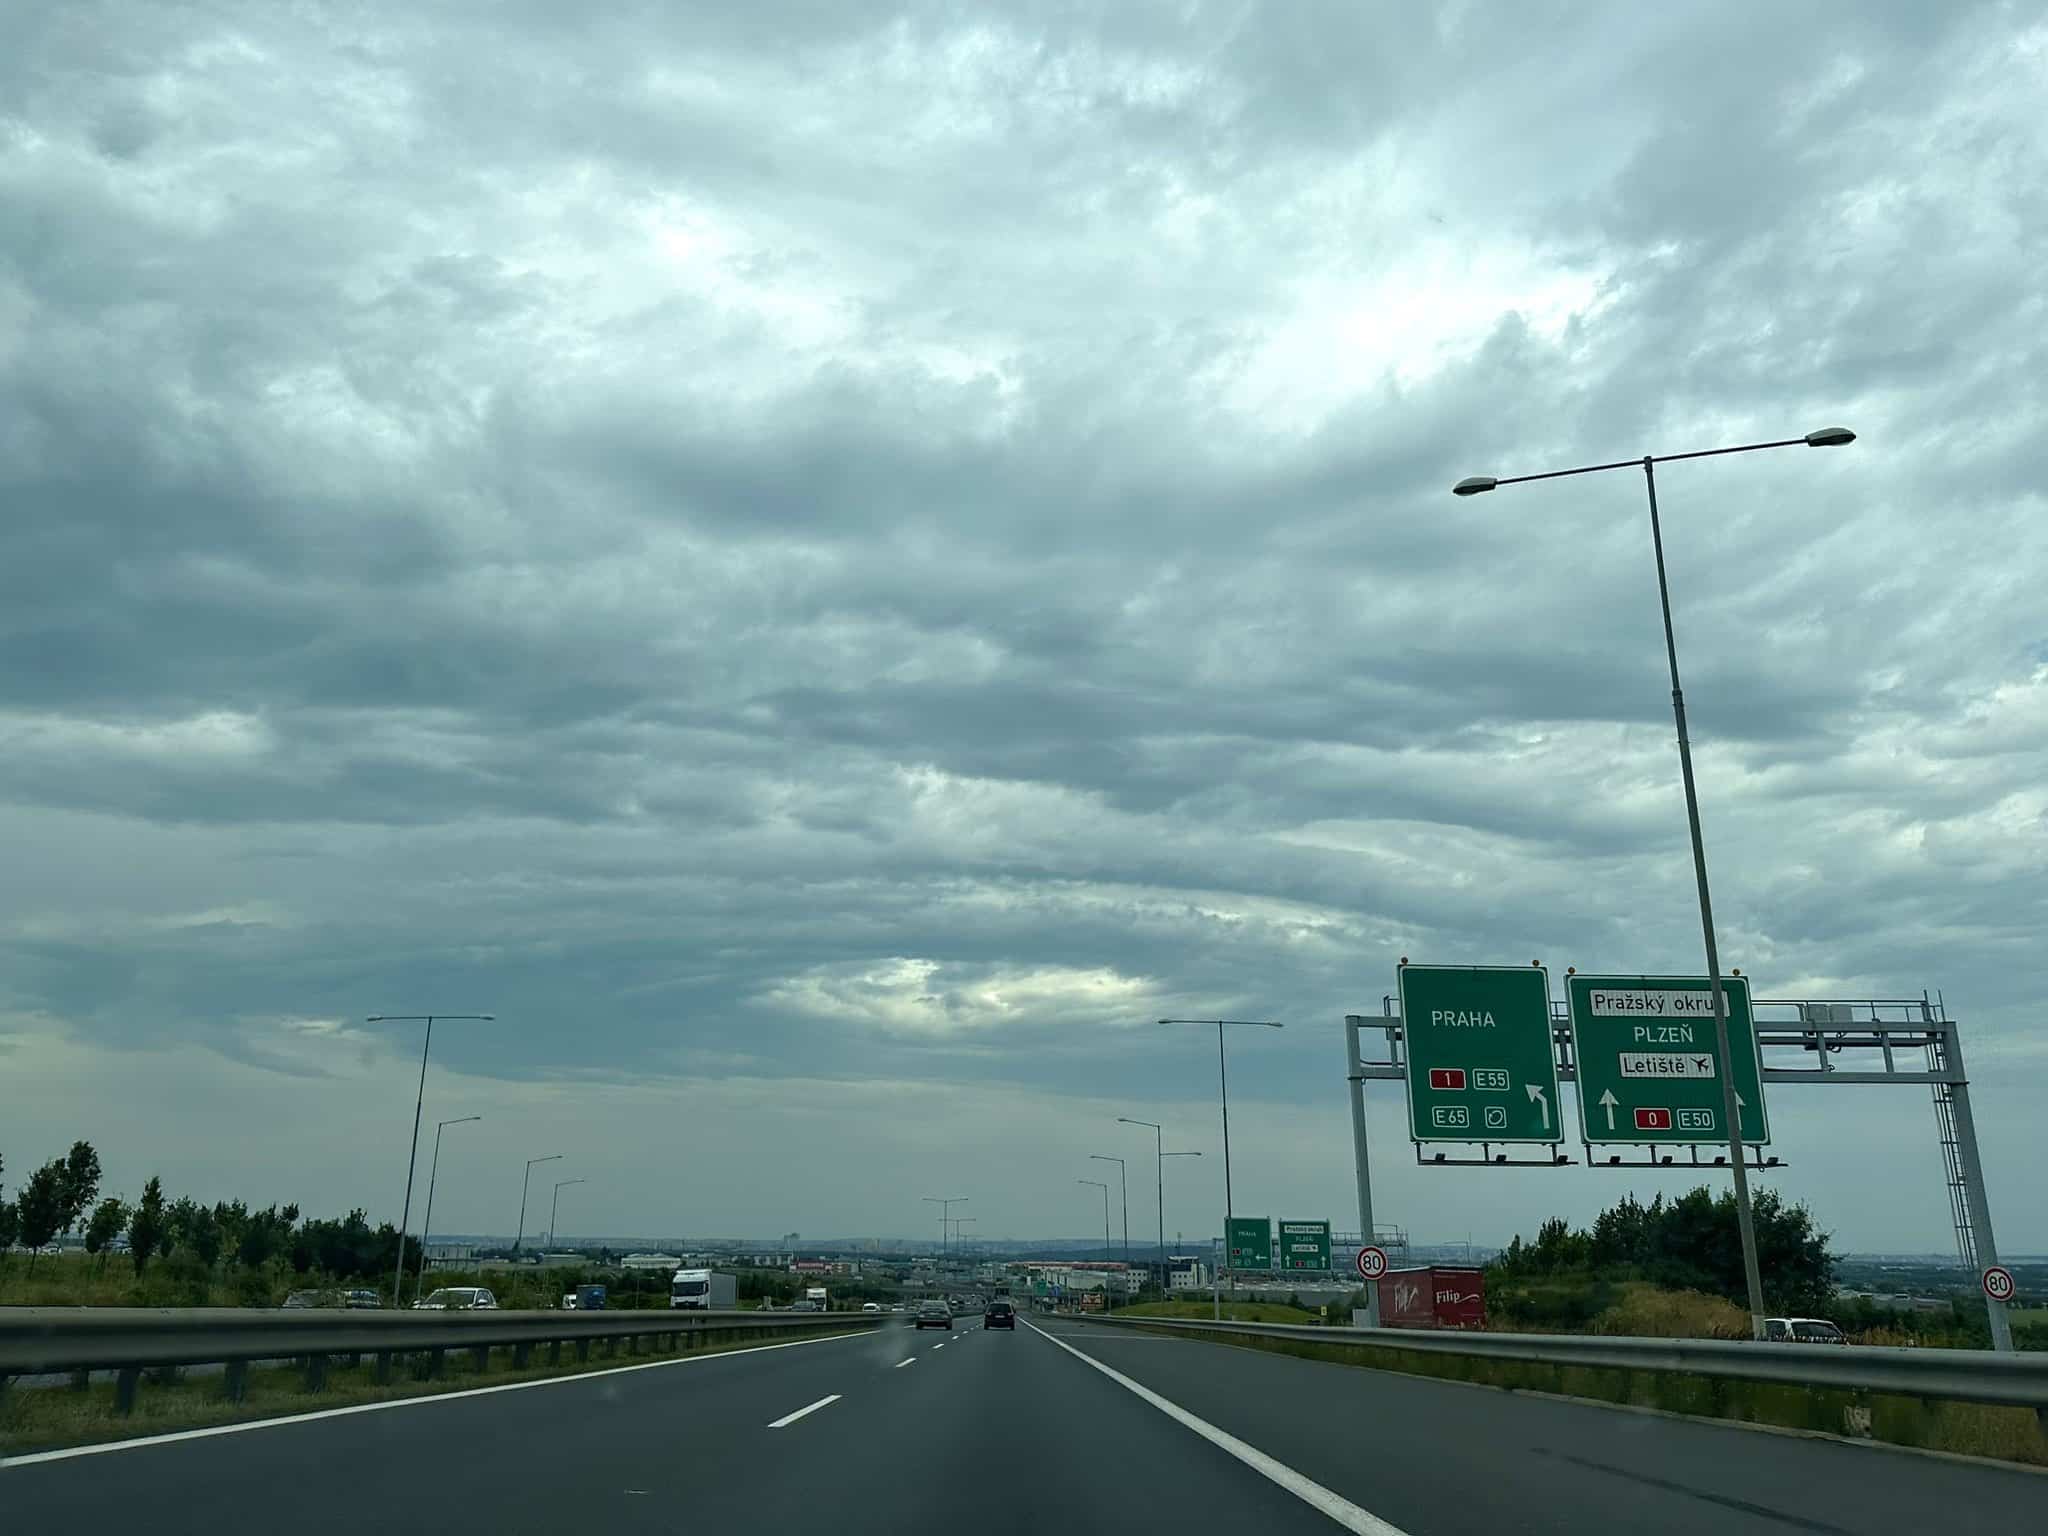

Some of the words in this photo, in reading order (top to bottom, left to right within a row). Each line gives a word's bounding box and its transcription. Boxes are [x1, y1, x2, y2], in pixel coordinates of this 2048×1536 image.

[1594, 993, 1665, 1014] Pražský
[1674, 995, 1714, 1011] okru
[1431, 1010, 1496, 1027] PRAHA
[1633, 1023, 1694, 1042] PLZEŇ
[1623, 1057, 1685, 1073] Letiště
[1444, 1071, 1451, 1087] 1
[1648, 1112, 1657, 1126] 0
[1363, 1255, 1381, 1270] 80
[1989, 1275, 2008, 1291] 80
[1436, 1289, 1460, 1304] Filip
